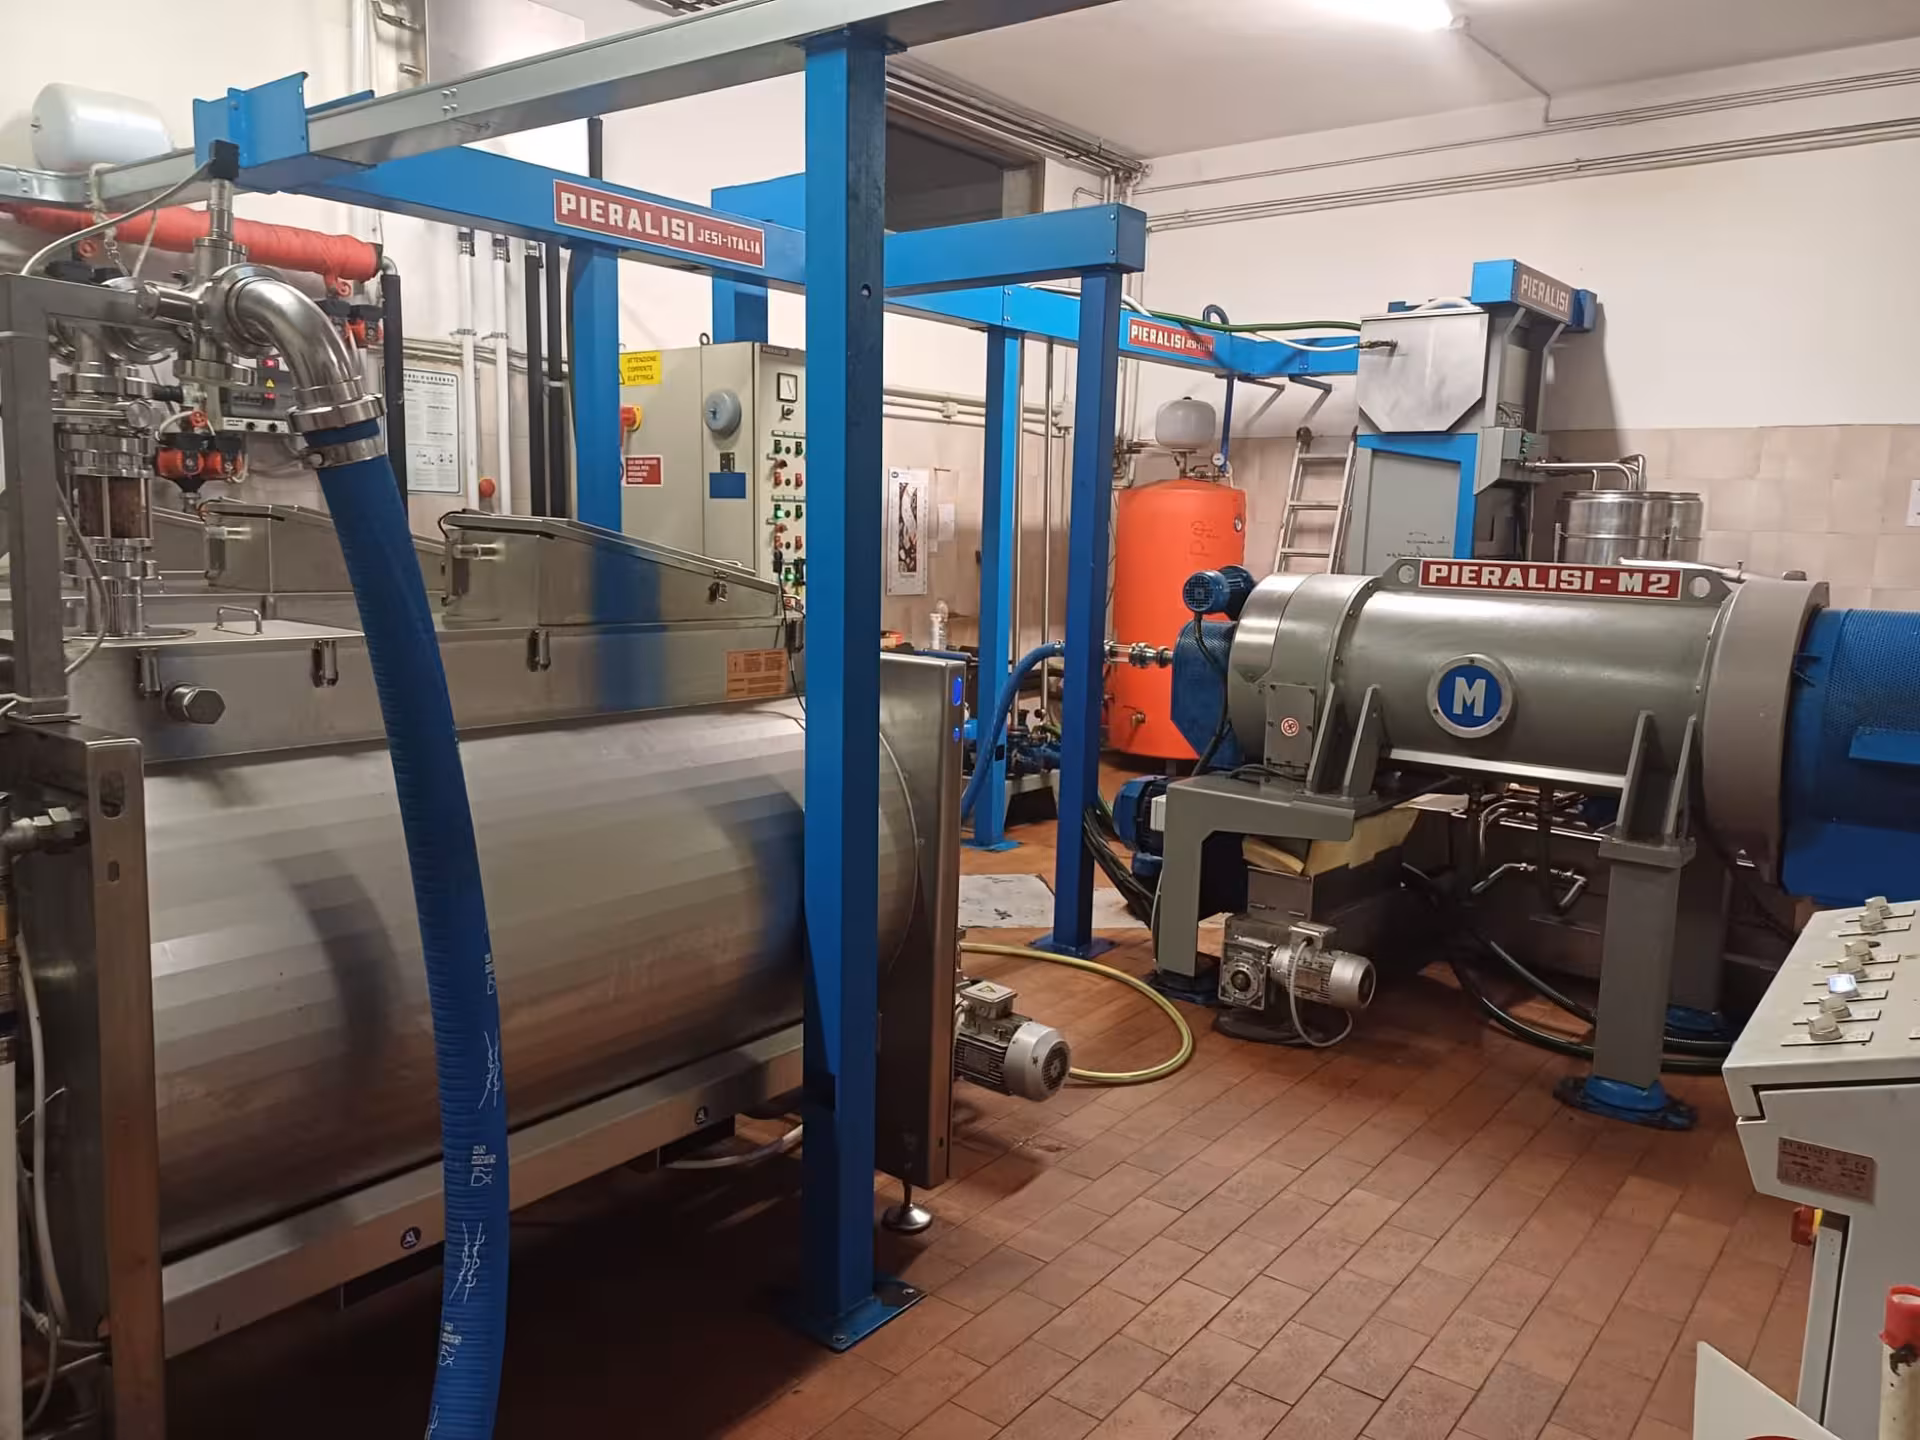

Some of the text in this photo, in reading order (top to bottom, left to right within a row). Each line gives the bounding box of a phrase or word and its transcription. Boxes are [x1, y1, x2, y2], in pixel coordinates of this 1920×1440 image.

[560, 191, 760, 254] PIERALISI JESI-ITALIA
[1521, 275, 1569, 312] PIERALISI
[1131, 325, 1185, 349] PIERALISI
[1452, 676, 1486, 717] M
